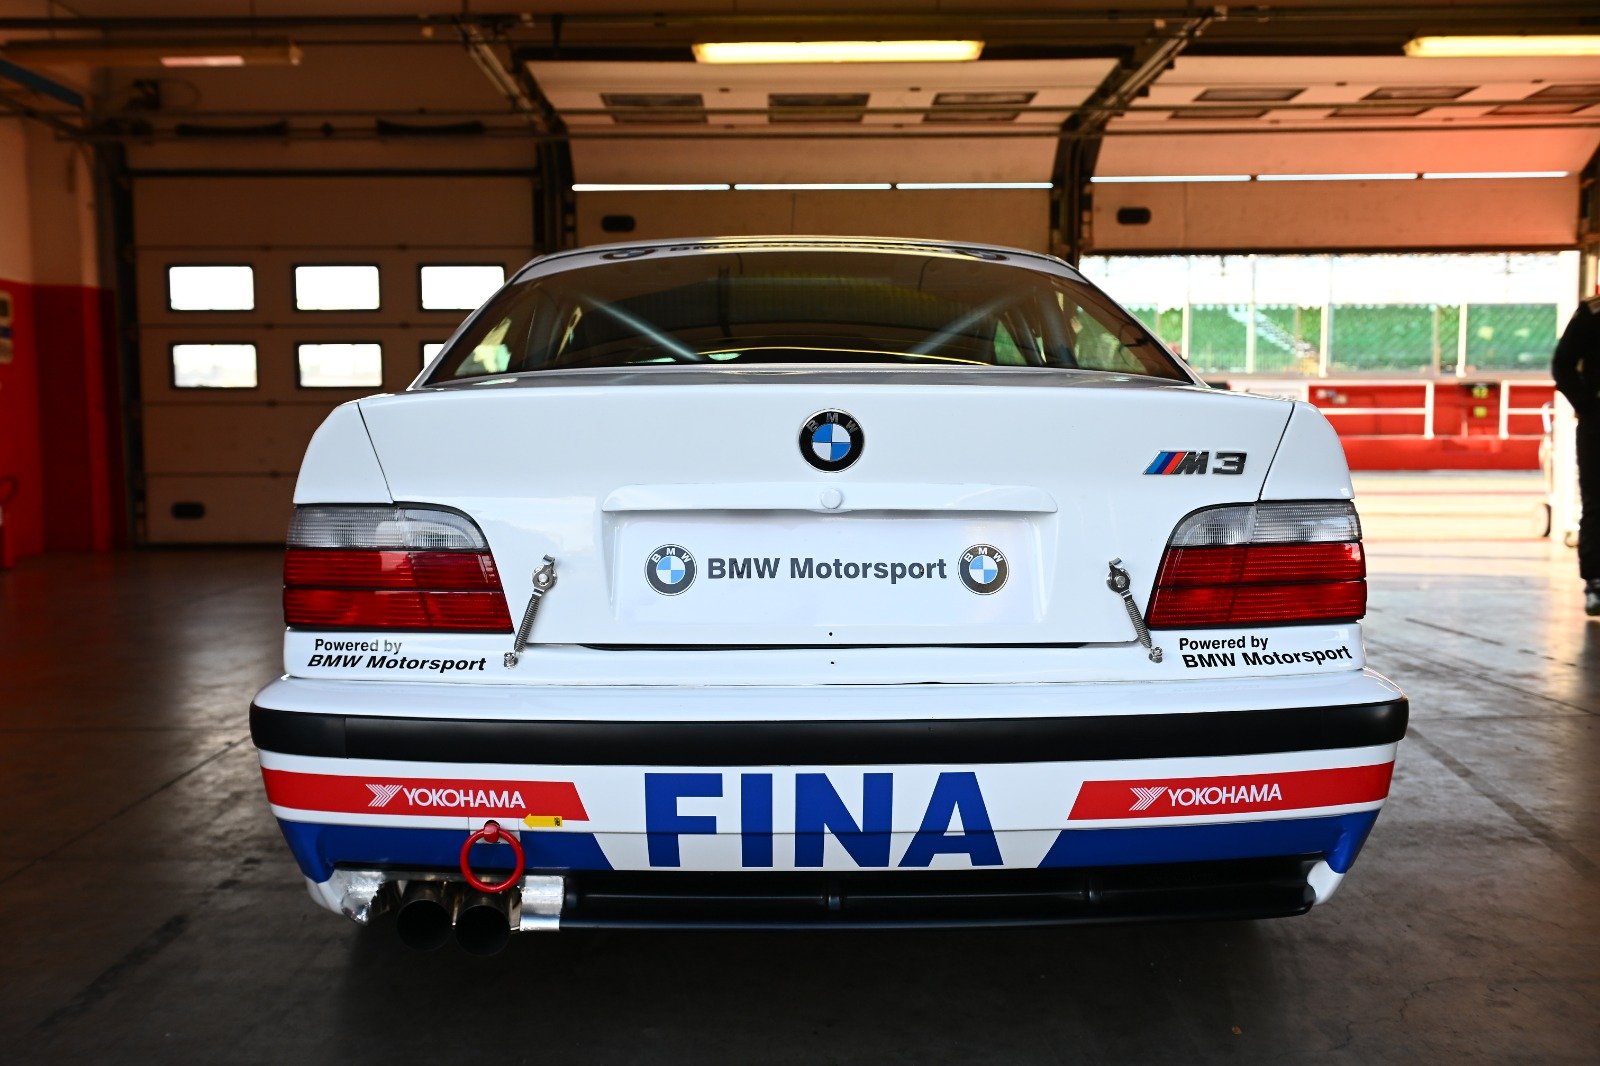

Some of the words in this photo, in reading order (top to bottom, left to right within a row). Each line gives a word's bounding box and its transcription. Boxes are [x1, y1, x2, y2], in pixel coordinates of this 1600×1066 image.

[806, 412, 858, 433] BMW
[1169, 451, 1248, 475] M3
[650, 547, 692, 564] BMW
[963, 547, 1004, 563] BMW
[707, 557, 781, 579] BMW
[790, 557, 948, 585] Motorsport
[314, 638, 379, 651] Powered
[384, 639, 402, 655] by
[1179, 635, 1246, 651] Powered
[1250, 635, 1269, 650] by
[307, 654, 364, 668] BMW
[366, 655, 487, 673] Motorsport
[1182, 652, 1236, 668] BMW
[1241, 645, 1353, 666] Motorsport
[402, 787, 527, 809] YOKOHAMA
[1167, 783, 1283, 807] YOKOHAMA
[644, 771, 1005, 868] FINA
